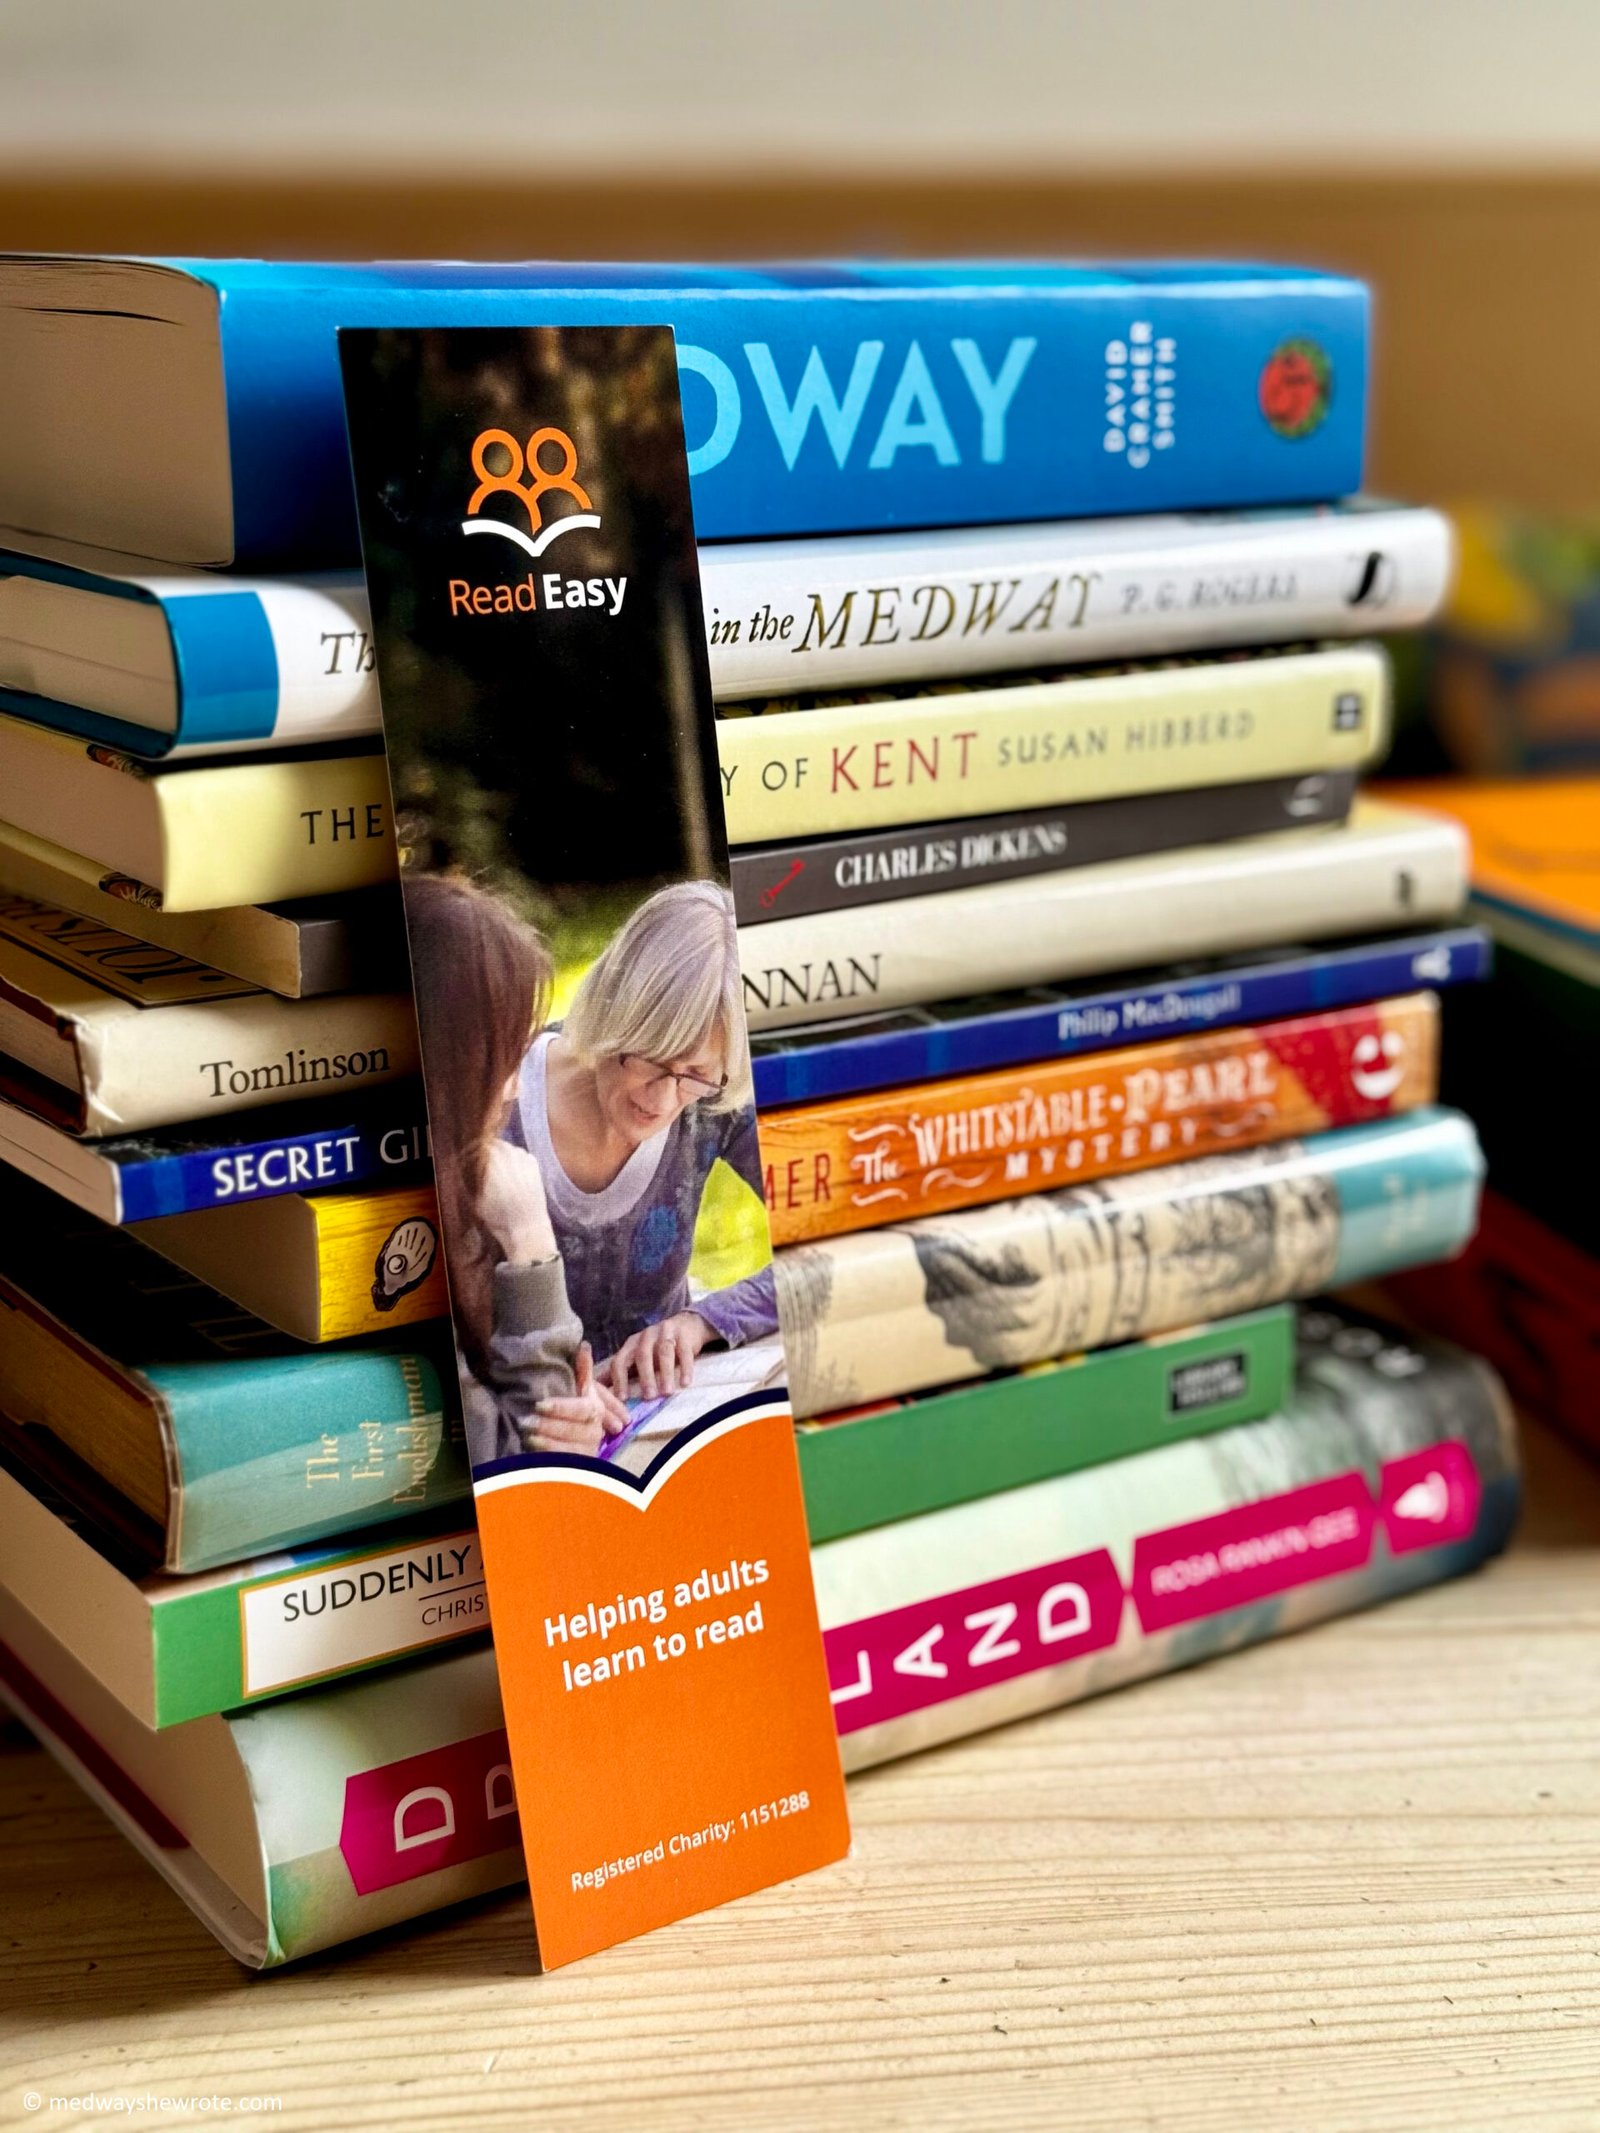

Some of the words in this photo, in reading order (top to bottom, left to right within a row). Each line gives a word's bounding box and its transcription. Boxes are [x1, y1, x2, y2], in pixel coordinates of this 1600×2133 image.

[1104, 339, 1128, 453] DAVID
[1153, 337, 1177, 450] SMITH
[449, 575, 536, 616] Read
[544, 573, 628, 616] Easy
[710, 608, 741, 645] in
[748, 603, 795, 643] the
[791, 571, 1104, 653] MEDWAY
[301, 804, 385, 845] THE
[720, 764, 739, 797] Y
[762, 757, 808, 791] OF
[831, 732, 978, 793] KENT
[998, 729, 1107, 767] SUSAN
[1125, 710, 1255, 752] HIBBERD
[835, 840, 956, 889] CHARLES
[961, 822, 1067, 870] DICKENS
[200, 1047, 390, 1098] Tomlinson
[741, 954, 881, 1012] NNAN
[212, 1136, 360, 1197] SECRET
[380, 1124, 433, 1165] GI
[1058, 1006, 1119, 1041] Philip
[1005, 1117, 1199, 1181] MYSTERY
[306, 1433, 340, 1488] The
[352, 1419, 384, 1481] First
[393, 1358, 434, 1504] Englishman
[283, 1544, 471, 1623] SUDDENLY
[422, 1593, 487, 1625] CHRIS
[543, 1588, 665, 1647] Helping
[674, 1558, 769, 1609] adults
[1150, 1551, 1221, 1597] ROSA
[563, 1641, 646, 1691] learn
[653, 1630, 686, 1661] to
[696, 1601, 764, 1650] read
[570, 1839, 665, 1892] Registered
[668, 1818, 736, 1859] Charity:
[740, 1790, 811, 1831] 1151288
